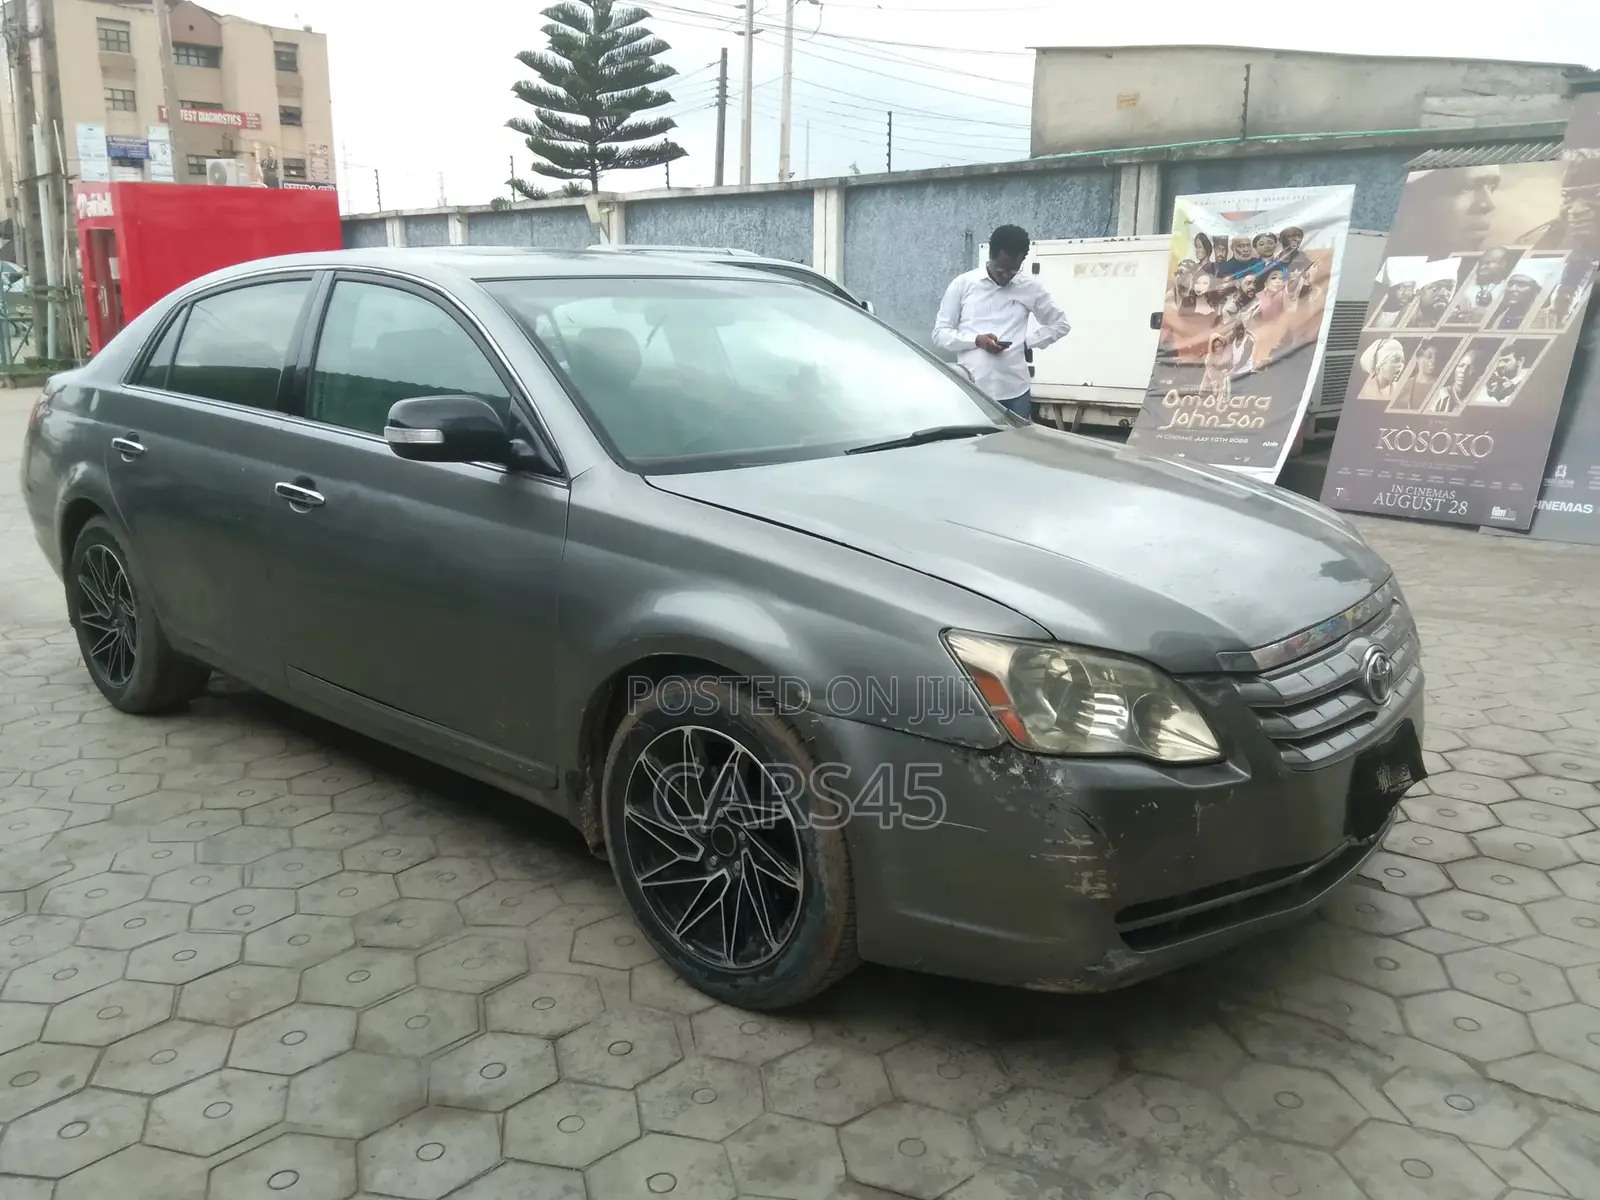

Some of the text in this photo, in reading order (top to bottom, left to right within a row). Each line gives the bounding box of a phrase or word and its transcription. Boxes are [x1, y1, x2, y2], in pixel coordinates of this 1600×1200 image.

[1391, 484, 1405, 494] IN
[1405, 485, 1457, 500] CINEMAS
[1373, 491, 1469, 515] AUGUST 28
[1536, 499, 1593, 514] INEMAS
